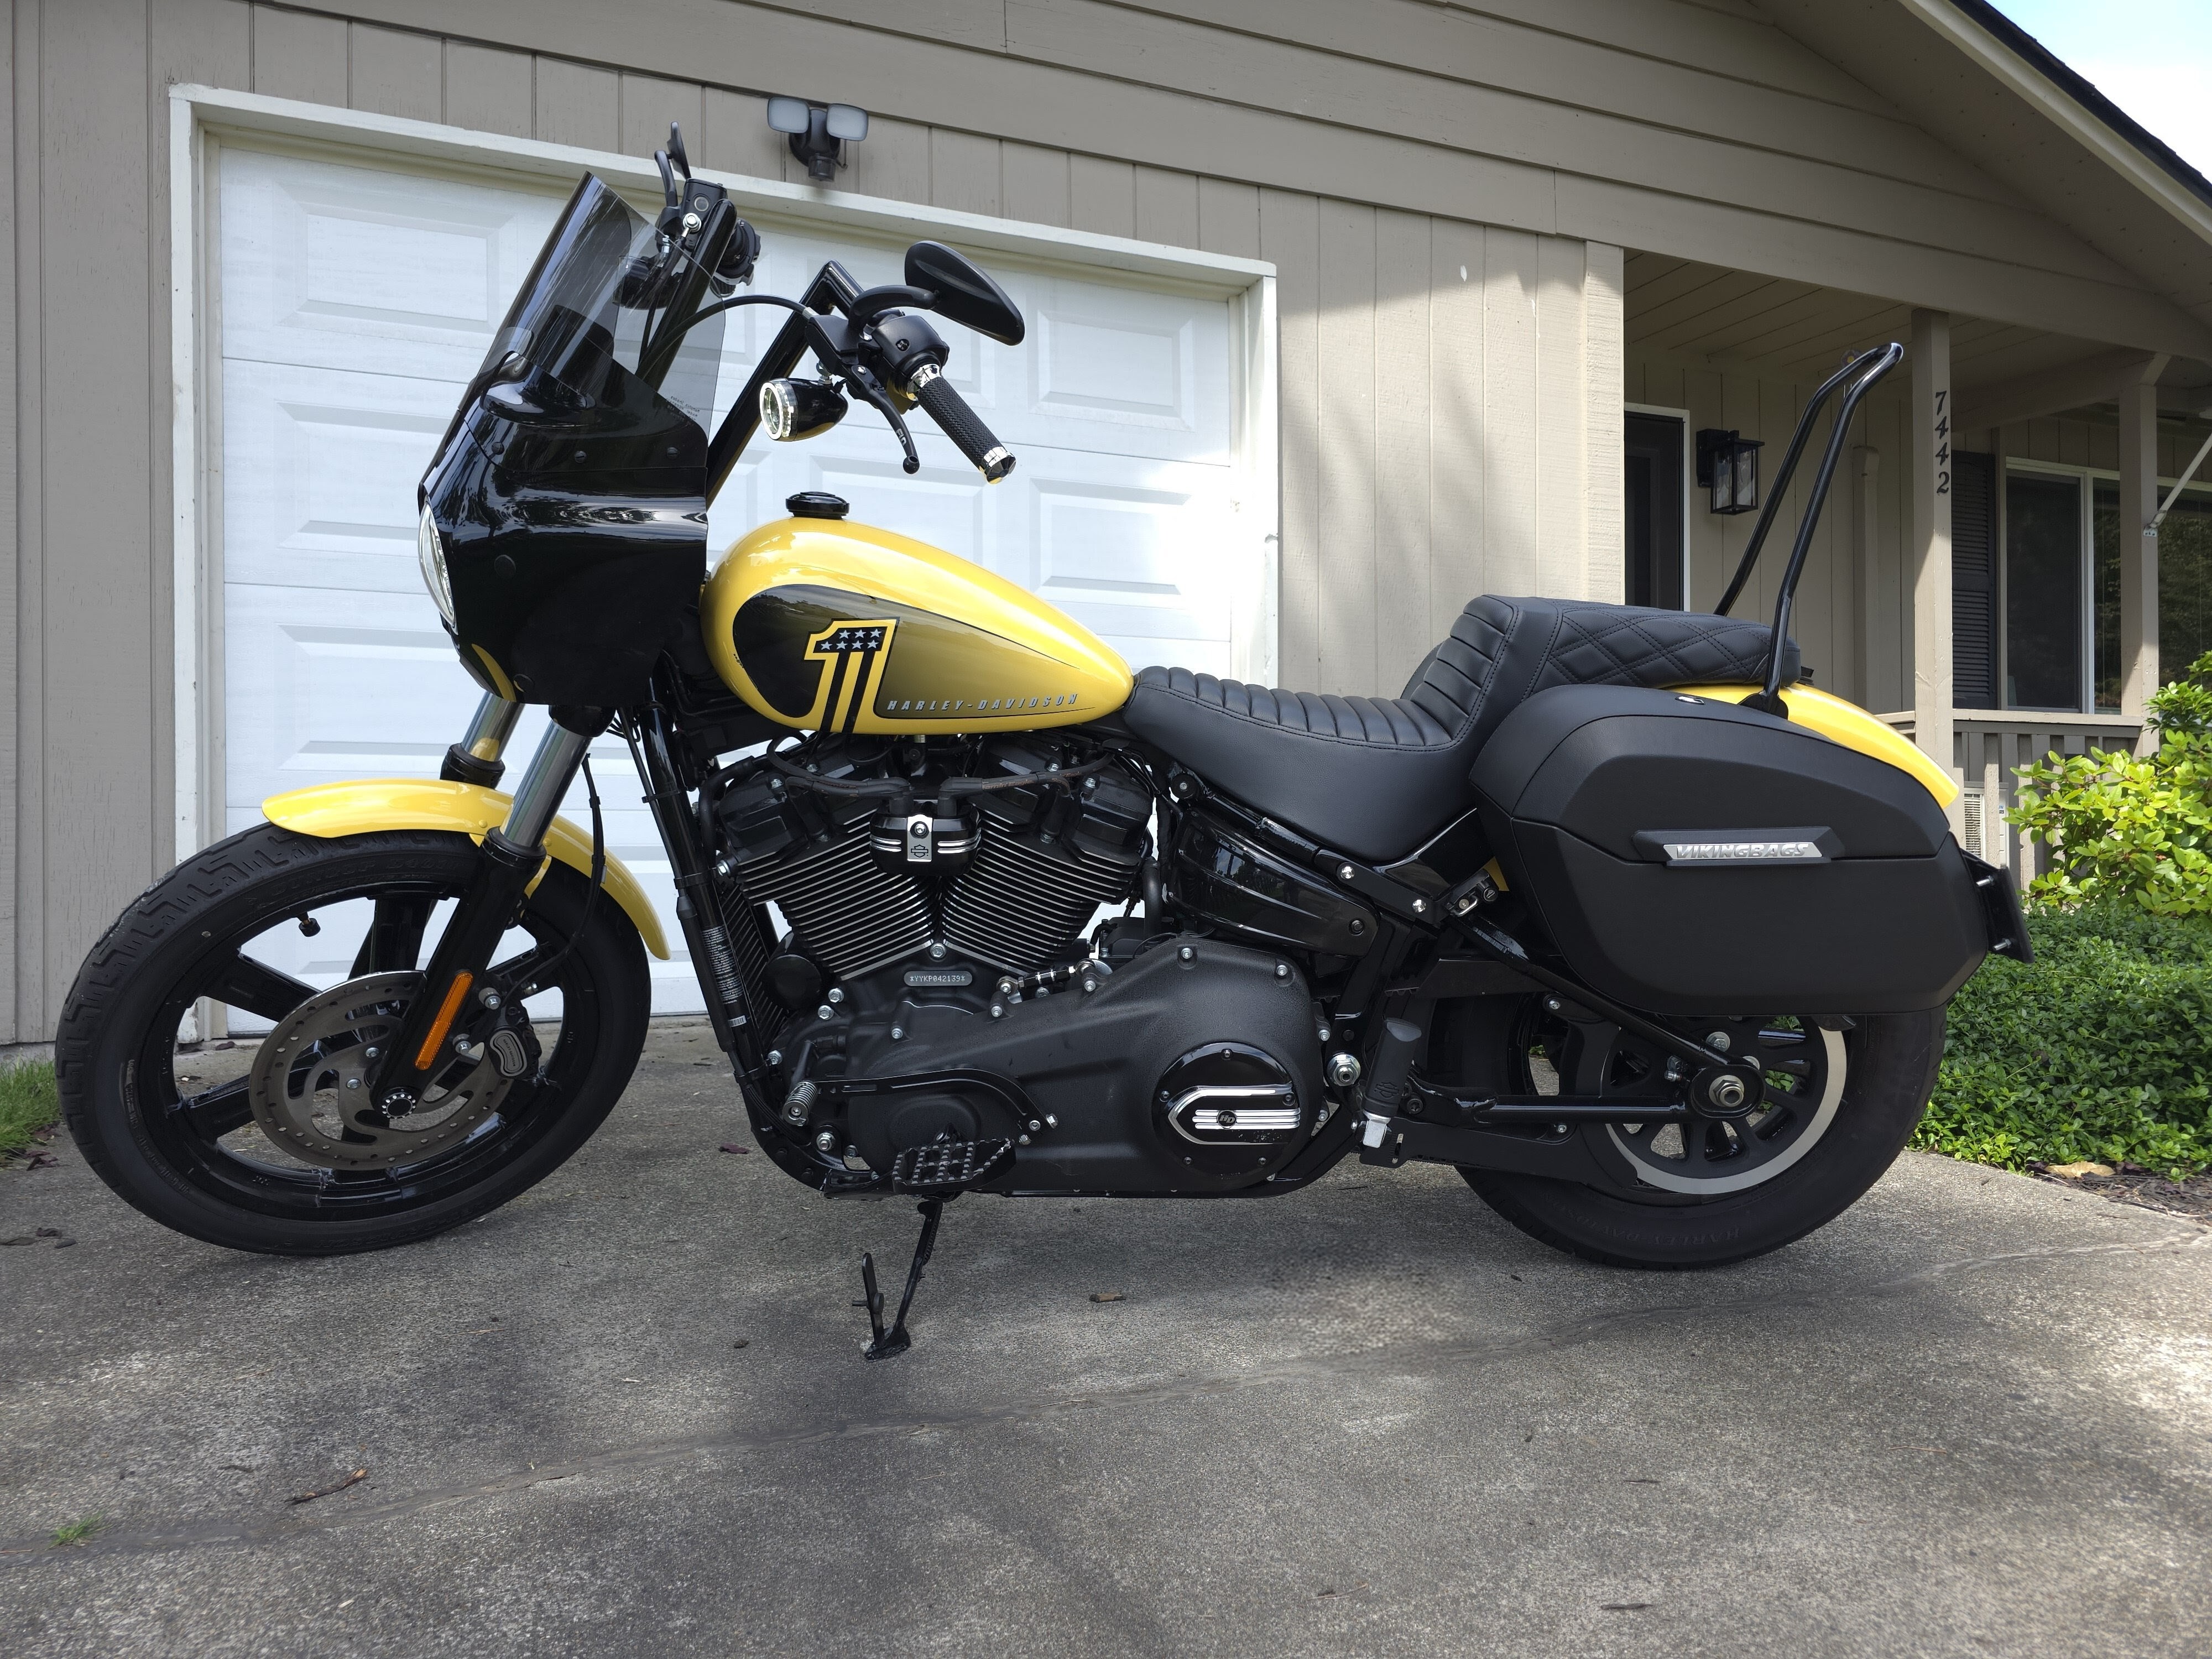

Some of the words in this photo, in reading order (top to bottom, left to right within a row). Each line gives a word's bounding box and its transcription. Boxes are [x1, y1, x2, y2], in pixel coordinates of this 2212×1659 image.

[1934, 390, 1949, 493] 7442
[887, 693, 1078, 711] HARLEY-DAVIDSON
[1677, 843, 1809, 859] VIKINGBAGS
[1219, 1115, 1235, 1123] HD
